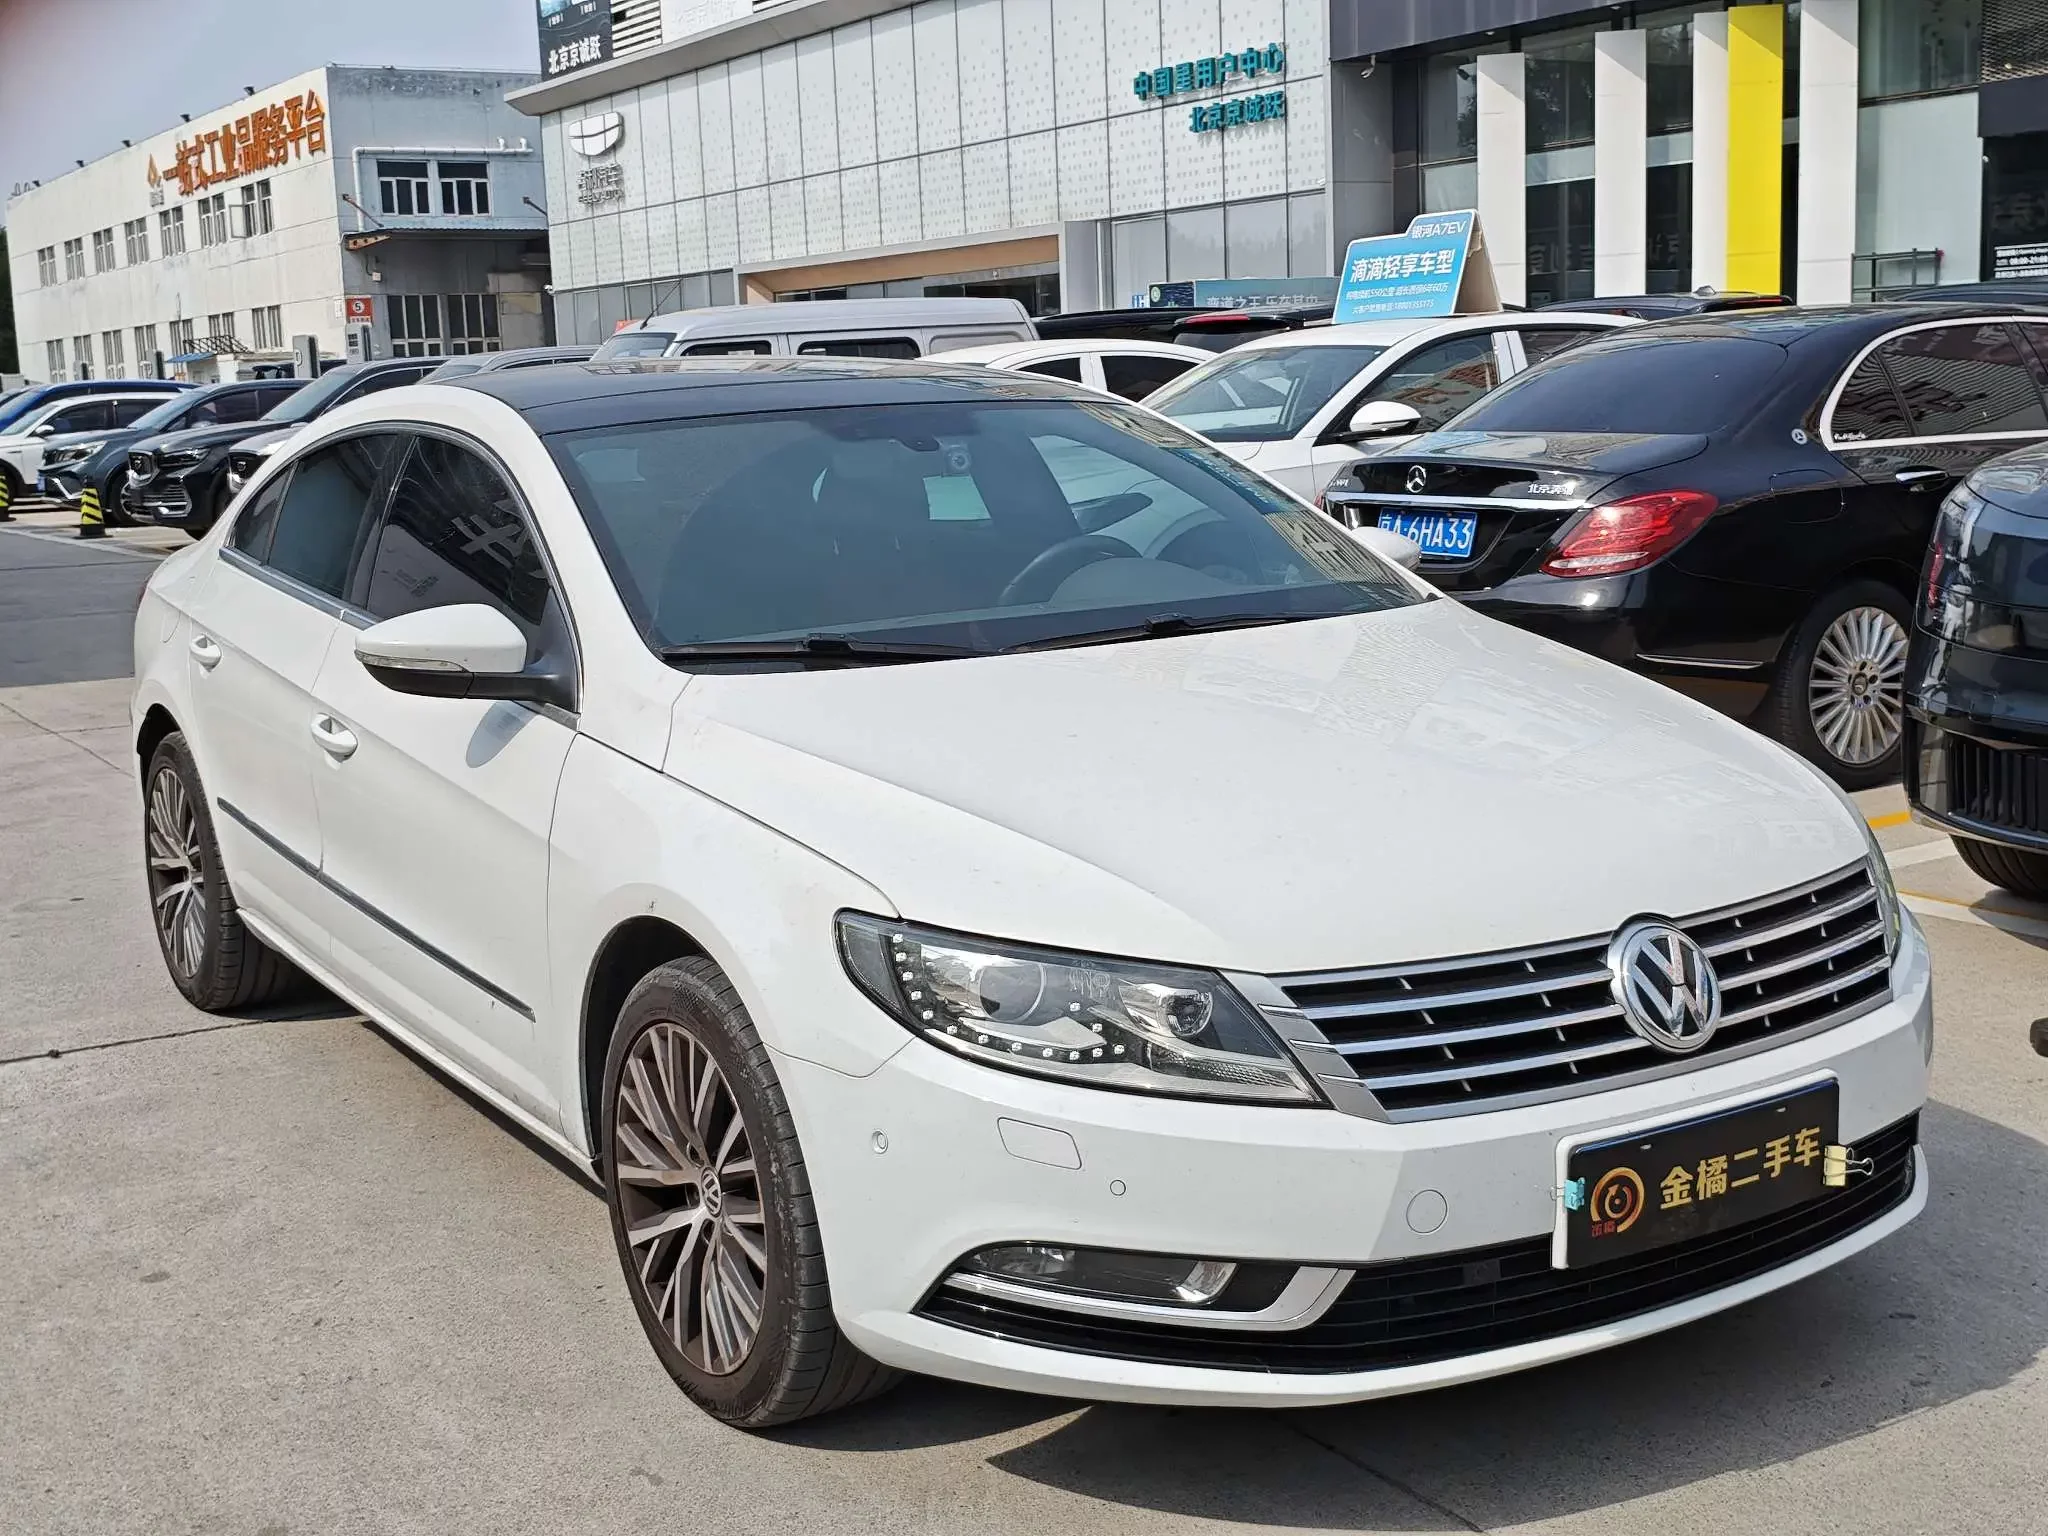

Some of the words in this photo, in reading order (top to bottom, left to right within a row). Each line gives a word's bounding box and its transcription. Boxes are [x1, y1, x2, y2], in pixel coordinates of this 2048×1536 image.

[548, 35, 602, 75] 北京京诚跃
[1133, 42, 1284, 100] 中国星用户中心
[1189, 91, 1285, 133] 北京京诚跃
[162, 89, 326, 197] 一站式工业品服务平台
[1411, 220, 1468, 239] 银河A7EV
[1349, 248, 1456, 284] 滴滴轻享车型
[1659, 1126, 1821, 1210] 金橘二手车
